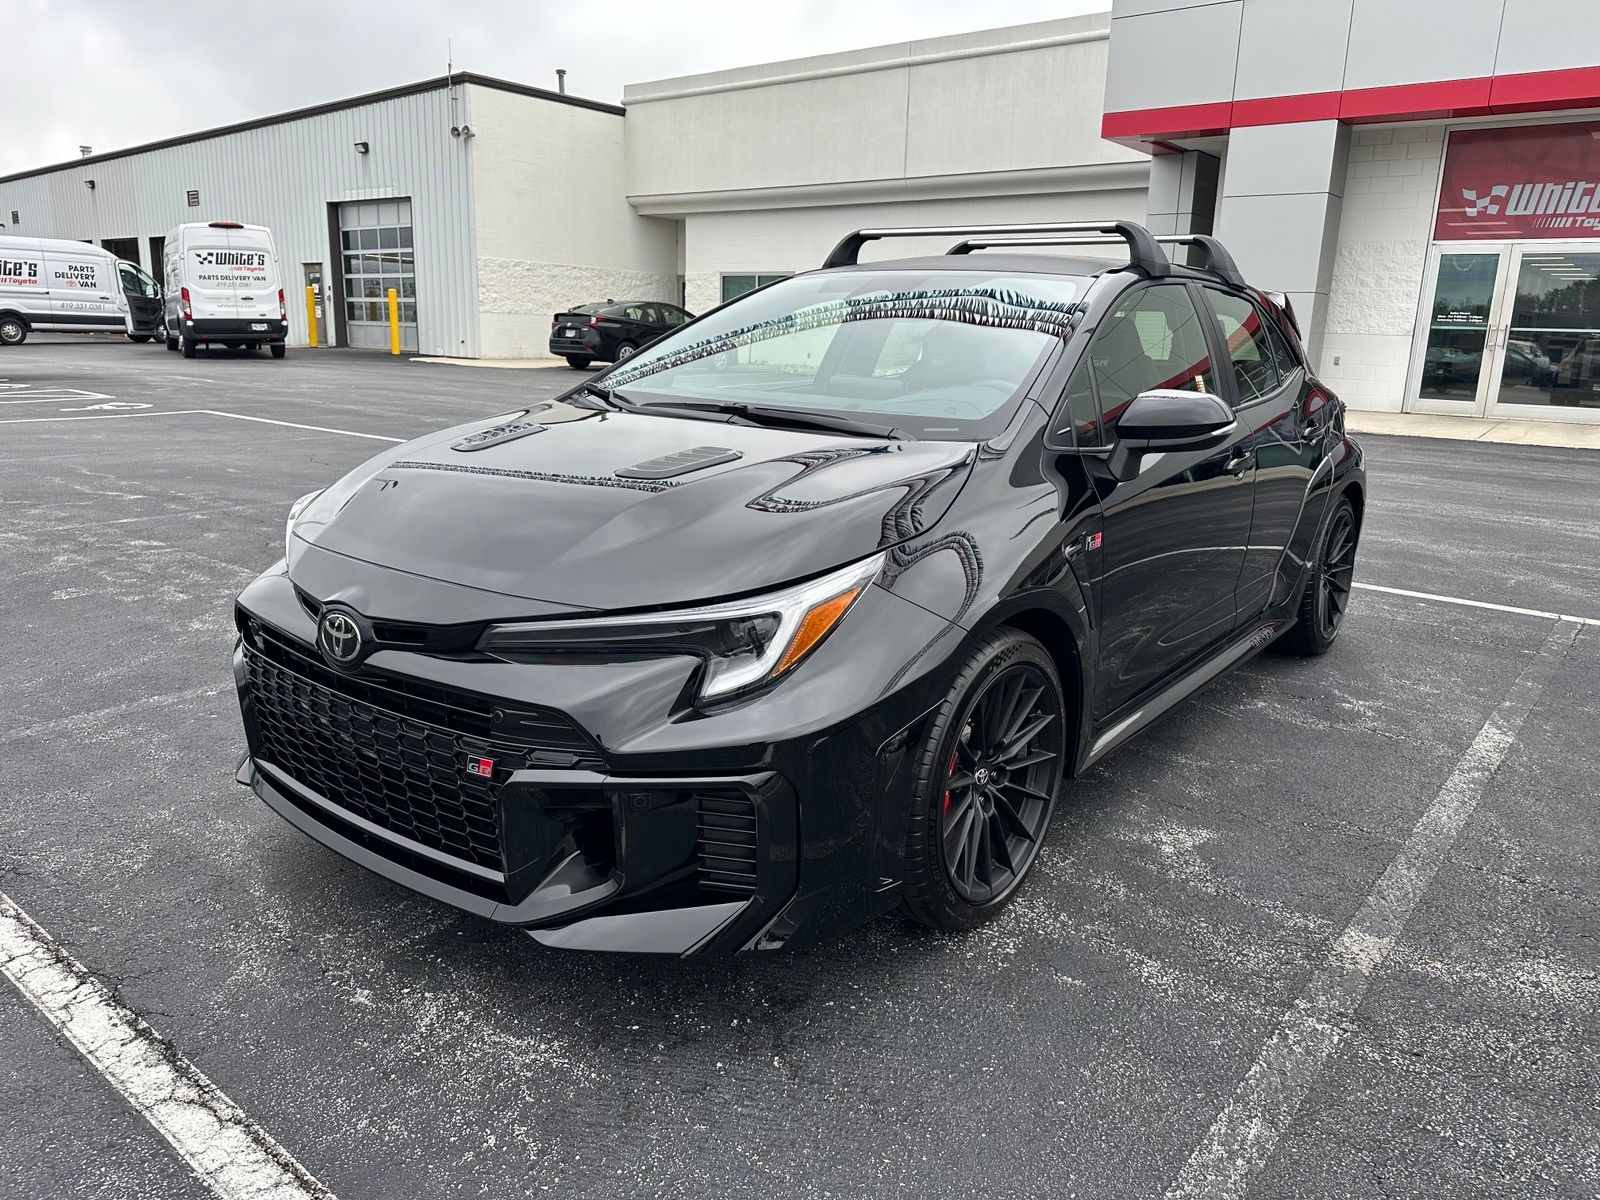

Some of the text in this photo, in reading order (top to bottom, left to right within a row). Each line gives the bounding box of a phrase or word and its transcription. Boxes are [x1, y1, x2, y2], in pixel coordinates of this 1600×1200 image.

[215, 252, 265, 266] White's
[68, 265, 95, 273] PARTS
[54, 271, 95, 280] DELIVERY
[8, 277, 38, 285] Toyota
[78, 280, 97, 288] VAN
[468, 762, 492, 777] GR
